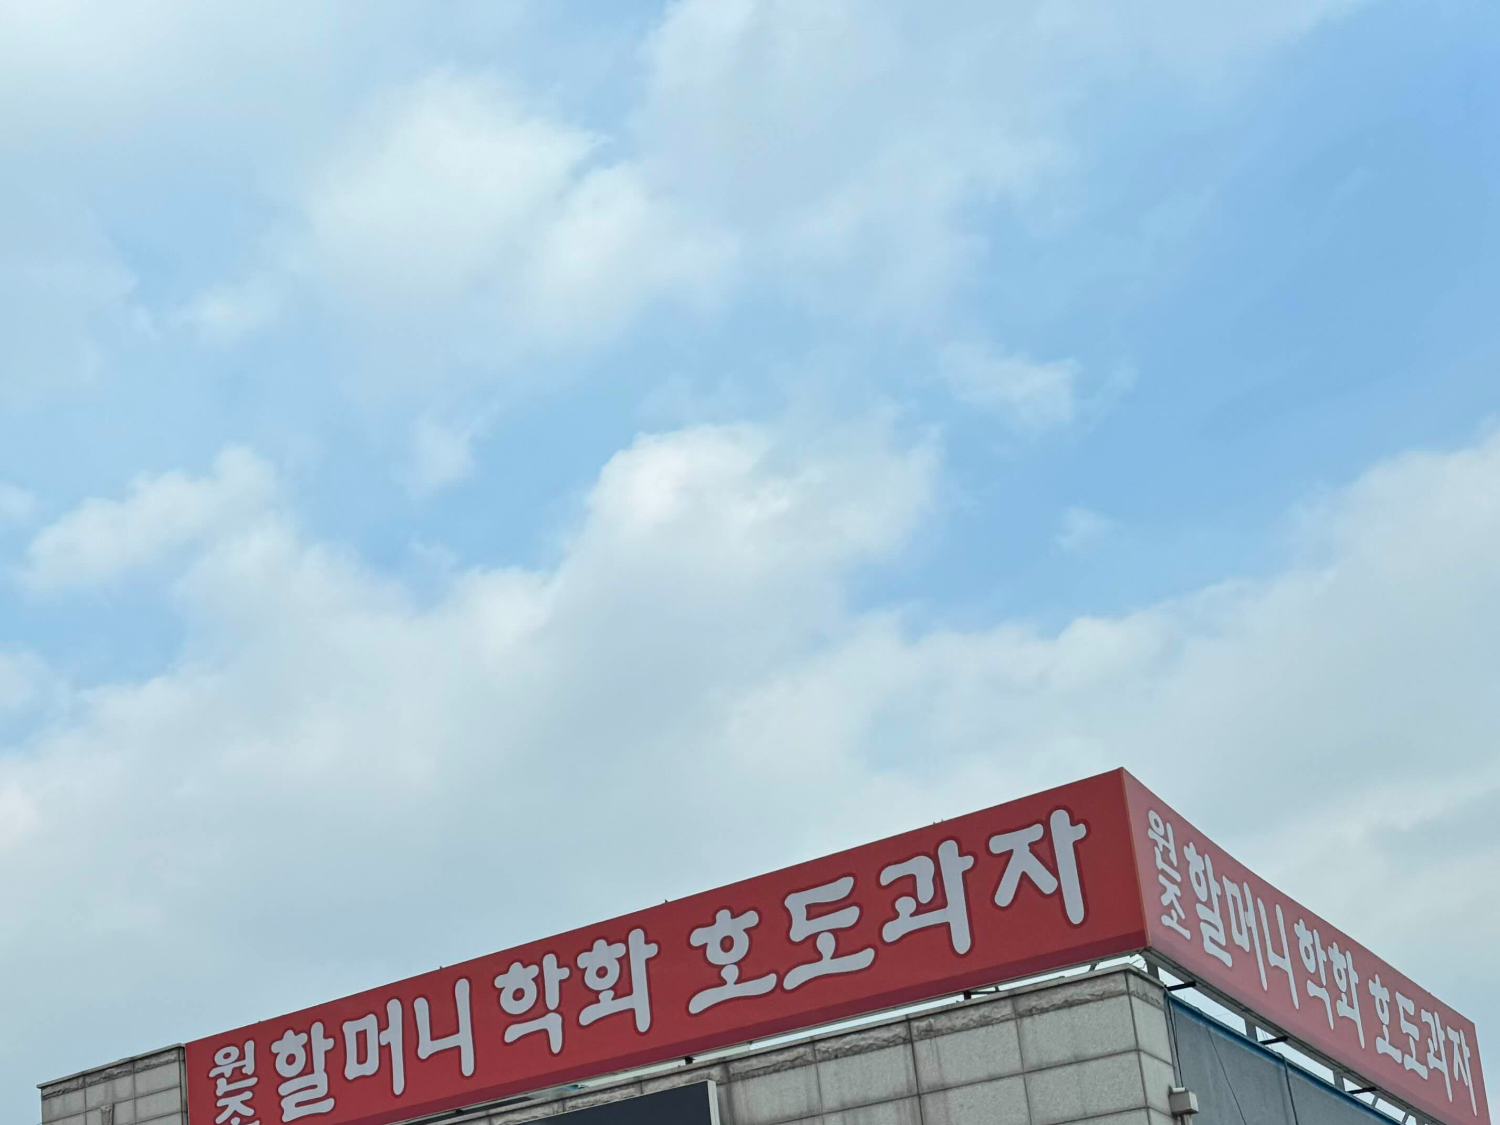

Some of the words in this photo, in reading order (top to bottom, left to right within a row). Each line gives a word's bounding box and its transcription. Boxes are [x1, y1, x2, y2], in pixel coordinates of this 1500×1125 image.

[270, 977, 476, 1124] 할머니
[493, 927, 659, 1055] 학화
[688, 808, 1087, 1015] 호도과자
[1147, 809, 1192, 941] 원조
[1183, 841, 1300, 1010] 할머니
[1293, 918, 1366, 1049] 학화
[1368, 973, 1479, 1117] 호도과자
